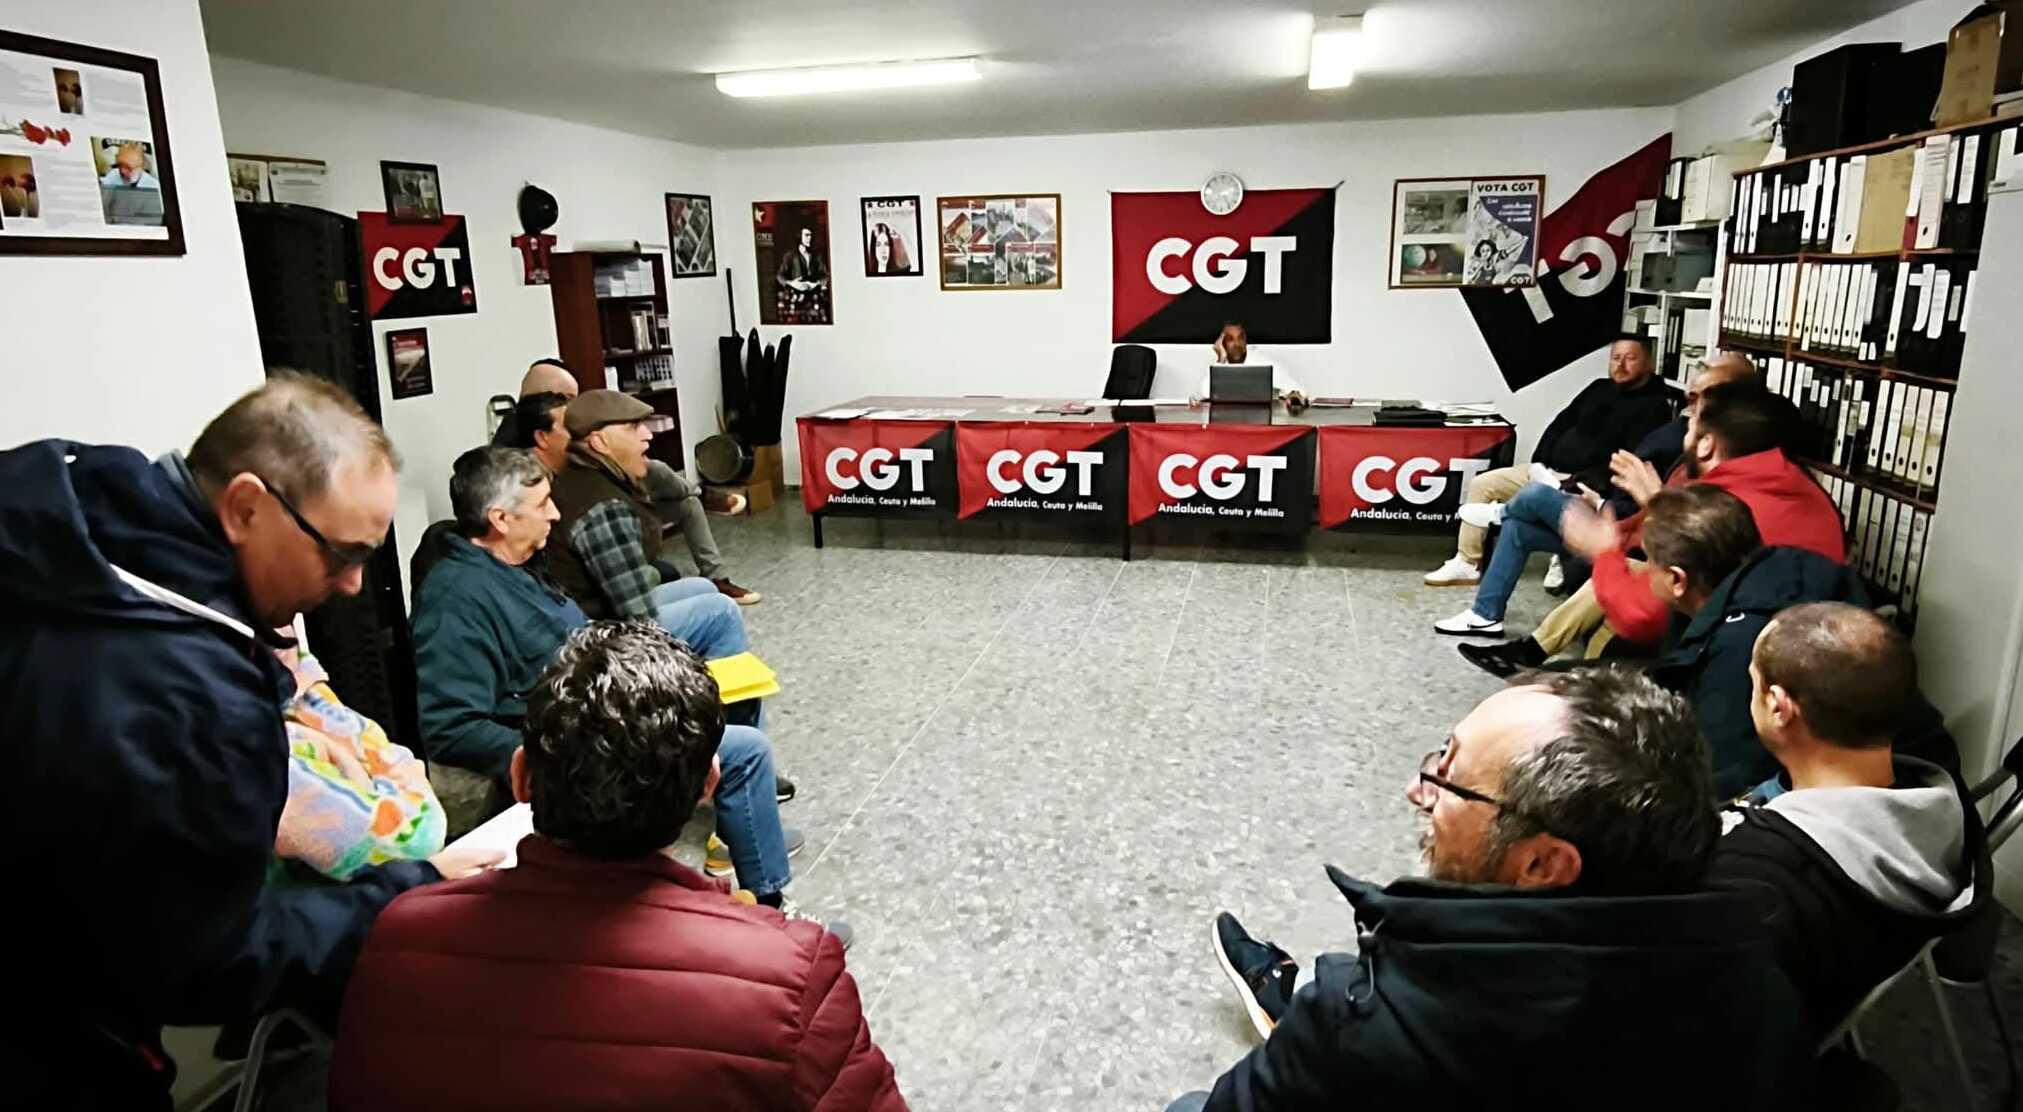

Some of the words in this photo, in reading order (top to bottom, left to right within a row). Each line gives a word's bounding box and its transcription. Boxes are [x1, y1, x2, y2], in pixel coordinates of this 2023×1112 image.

[877, 199, 904, 208] CGT
[1477, 184, 1508, 192] VOTA
[1512, 183, 1534, 192] CGT
[373, 247, 461, 291] CGT
[1146, 236, 1297, 295] CGT
[825, 447, 934, 492] CGT
[986, 449, 1104, 496] CGT
[1158, 453, 1287, 502] CGT
[1351, 456, 1491, 505] CGT
[1042, 501, 1066, 510] Ceuta
[1068, 503, 1073, 511] y
[1075, 502, 1103, 511] Melilla
[1218, 506, 1244, 516] Ceuta
[1246, 509, 1252, 518] y
[1254, 508, 1285, 517] Melilla
[1416, 512, 1443, 521] Ceuta
[1445, 514, 1451, 523] y
